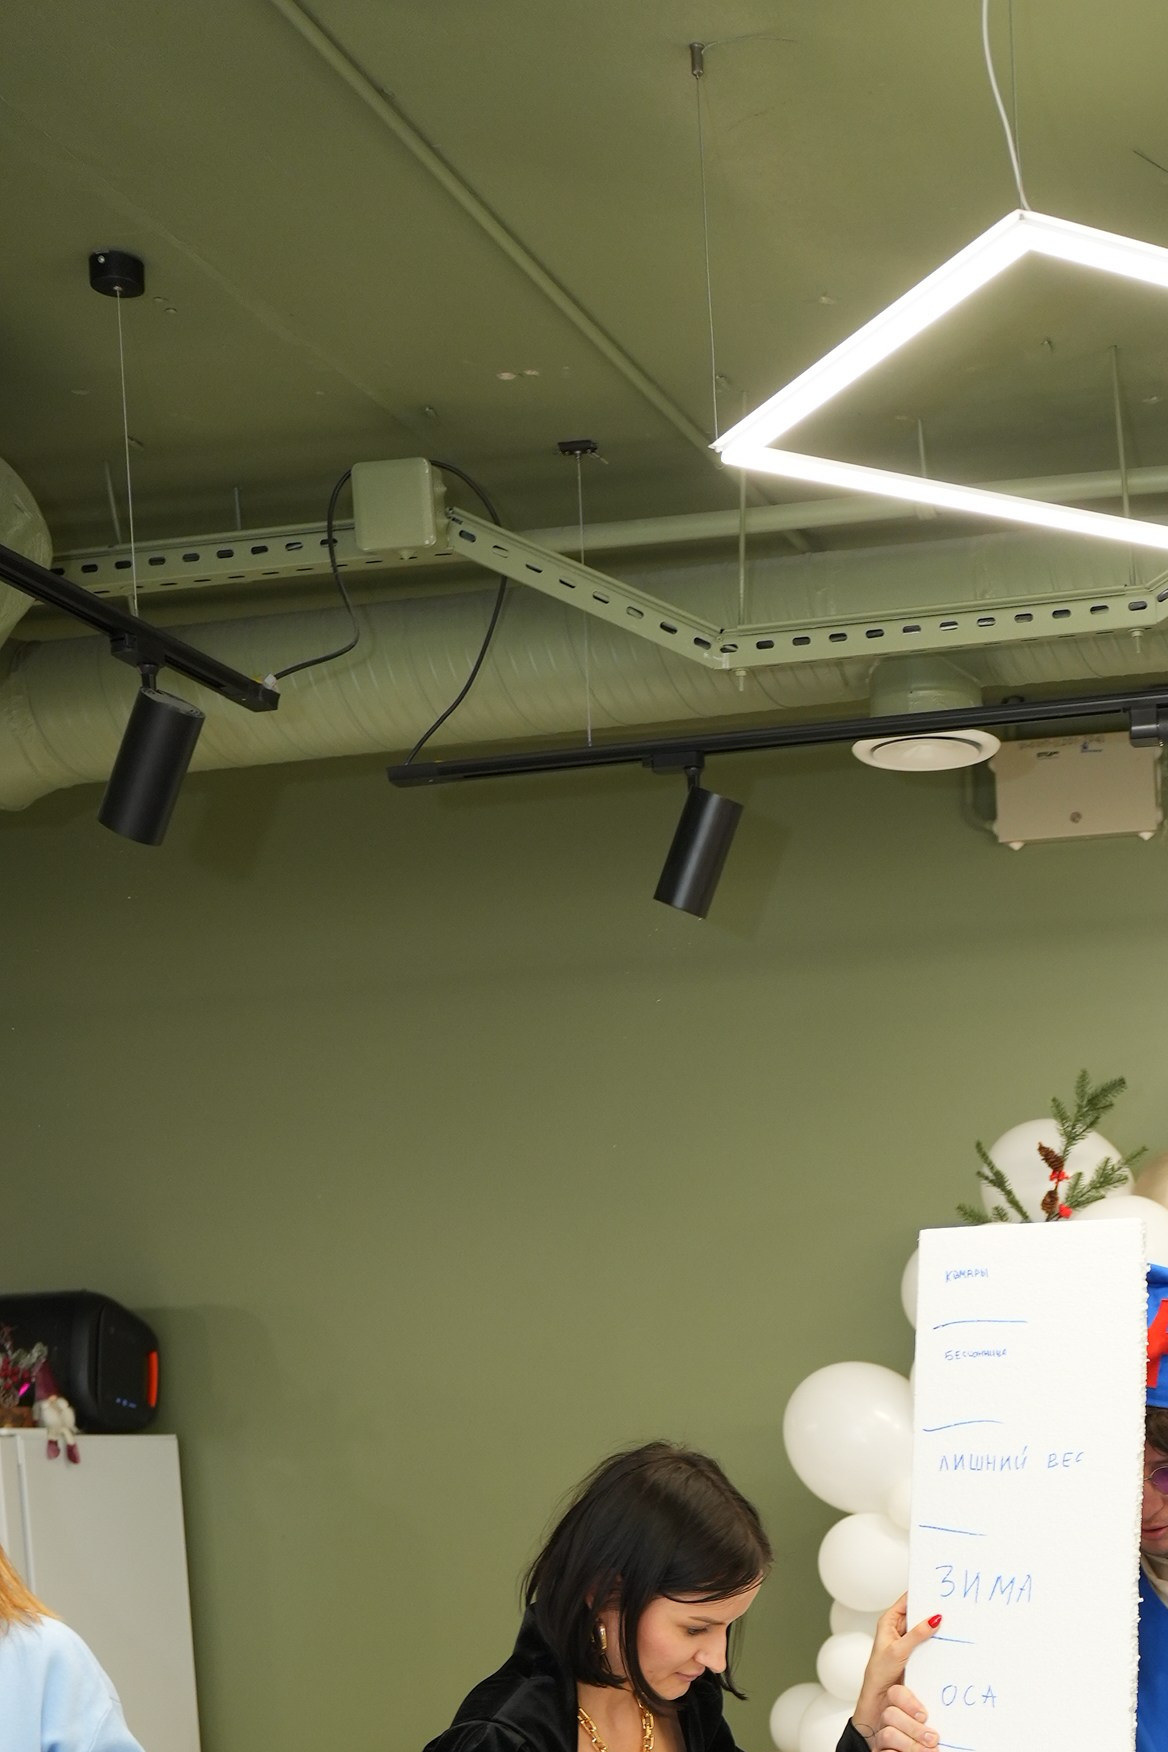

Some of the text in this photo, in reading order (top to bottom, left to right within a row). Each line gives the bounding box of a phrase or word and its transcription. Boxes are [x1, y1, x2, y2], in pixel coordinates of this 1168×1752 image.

[938, 1445, 1085, 1472] ЛИШНИЙ ВЕС
[935, 1564, 1033, 1606] ЗИМА
[941, 1684, 998, 1708] ОСА
